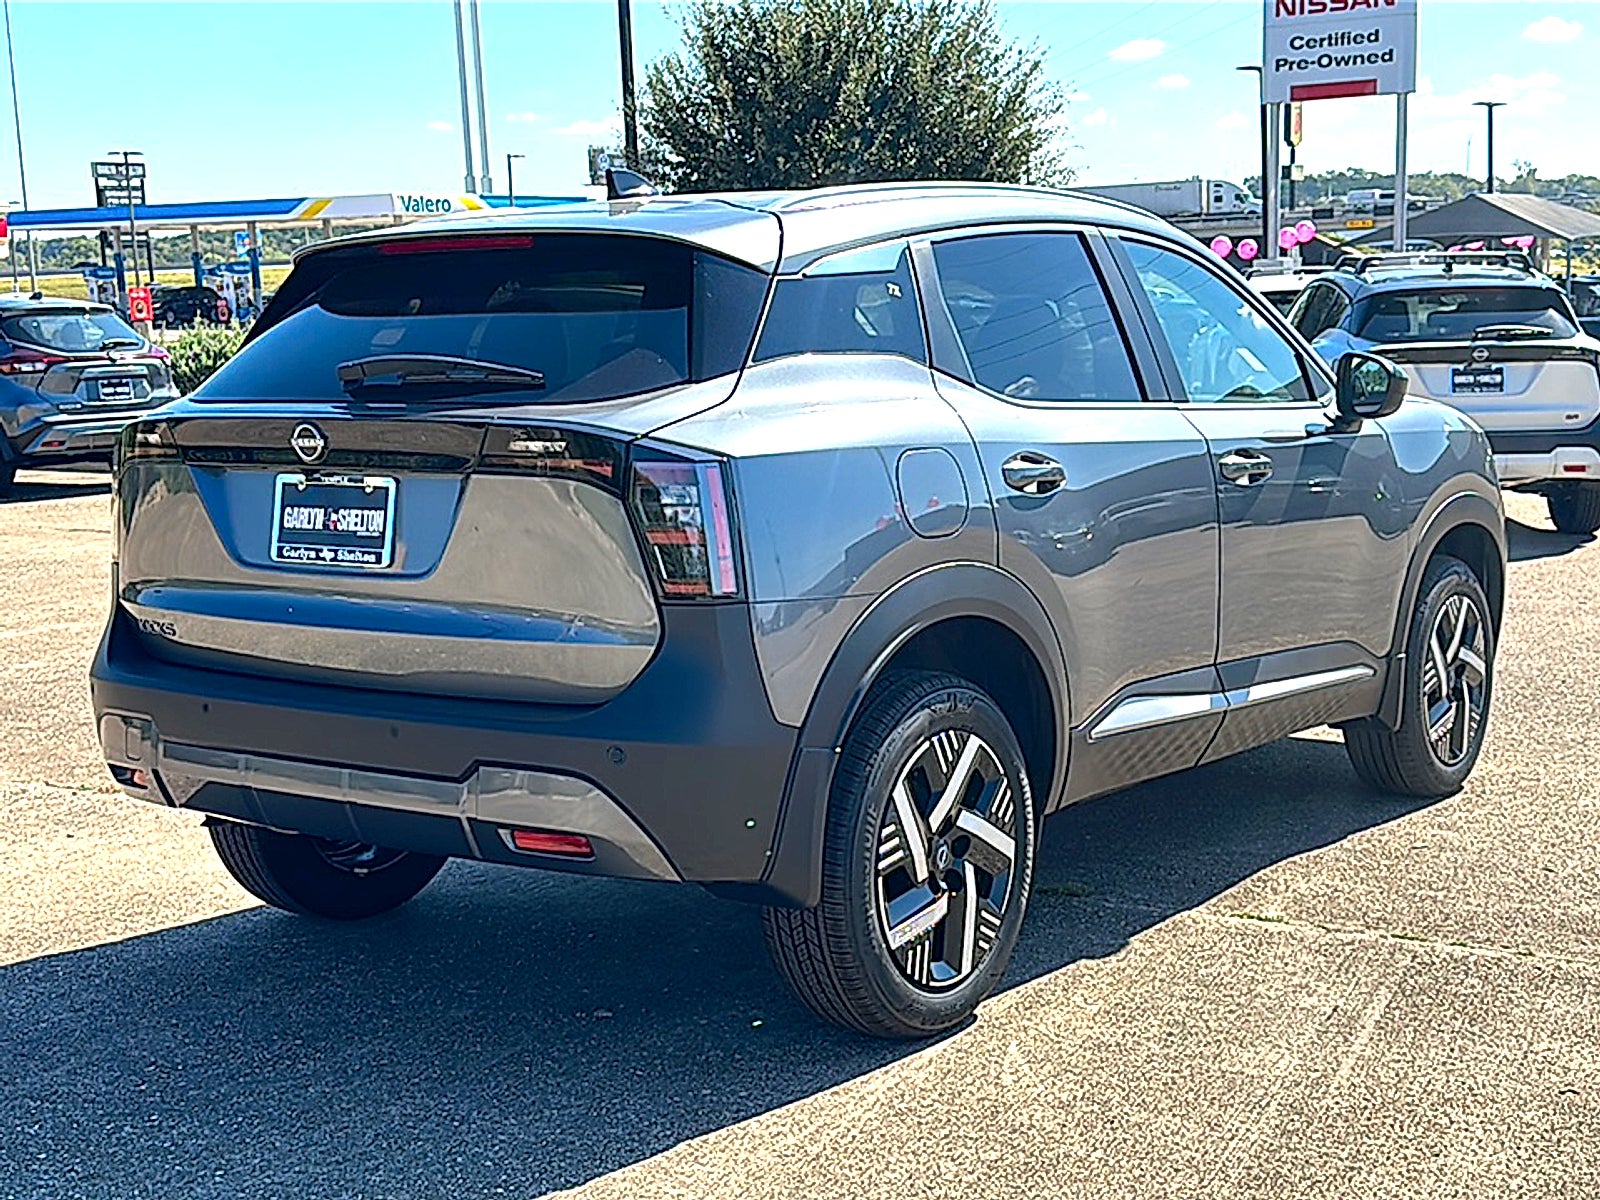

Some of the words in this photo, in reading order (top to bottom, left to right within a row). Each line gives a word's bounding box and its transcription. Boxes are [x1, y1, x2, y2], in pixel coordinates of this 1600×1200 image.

[1289, 29, 1380, 50] Certified
[1275, 48, 1394, 72] Pre-Owned
[398, 195, 451, 212] Valero
[284, 507, 325, 529] GARLYN
[338, 509, 385, 532] SHELTON
[337, 549, 376, 562] Shelton
